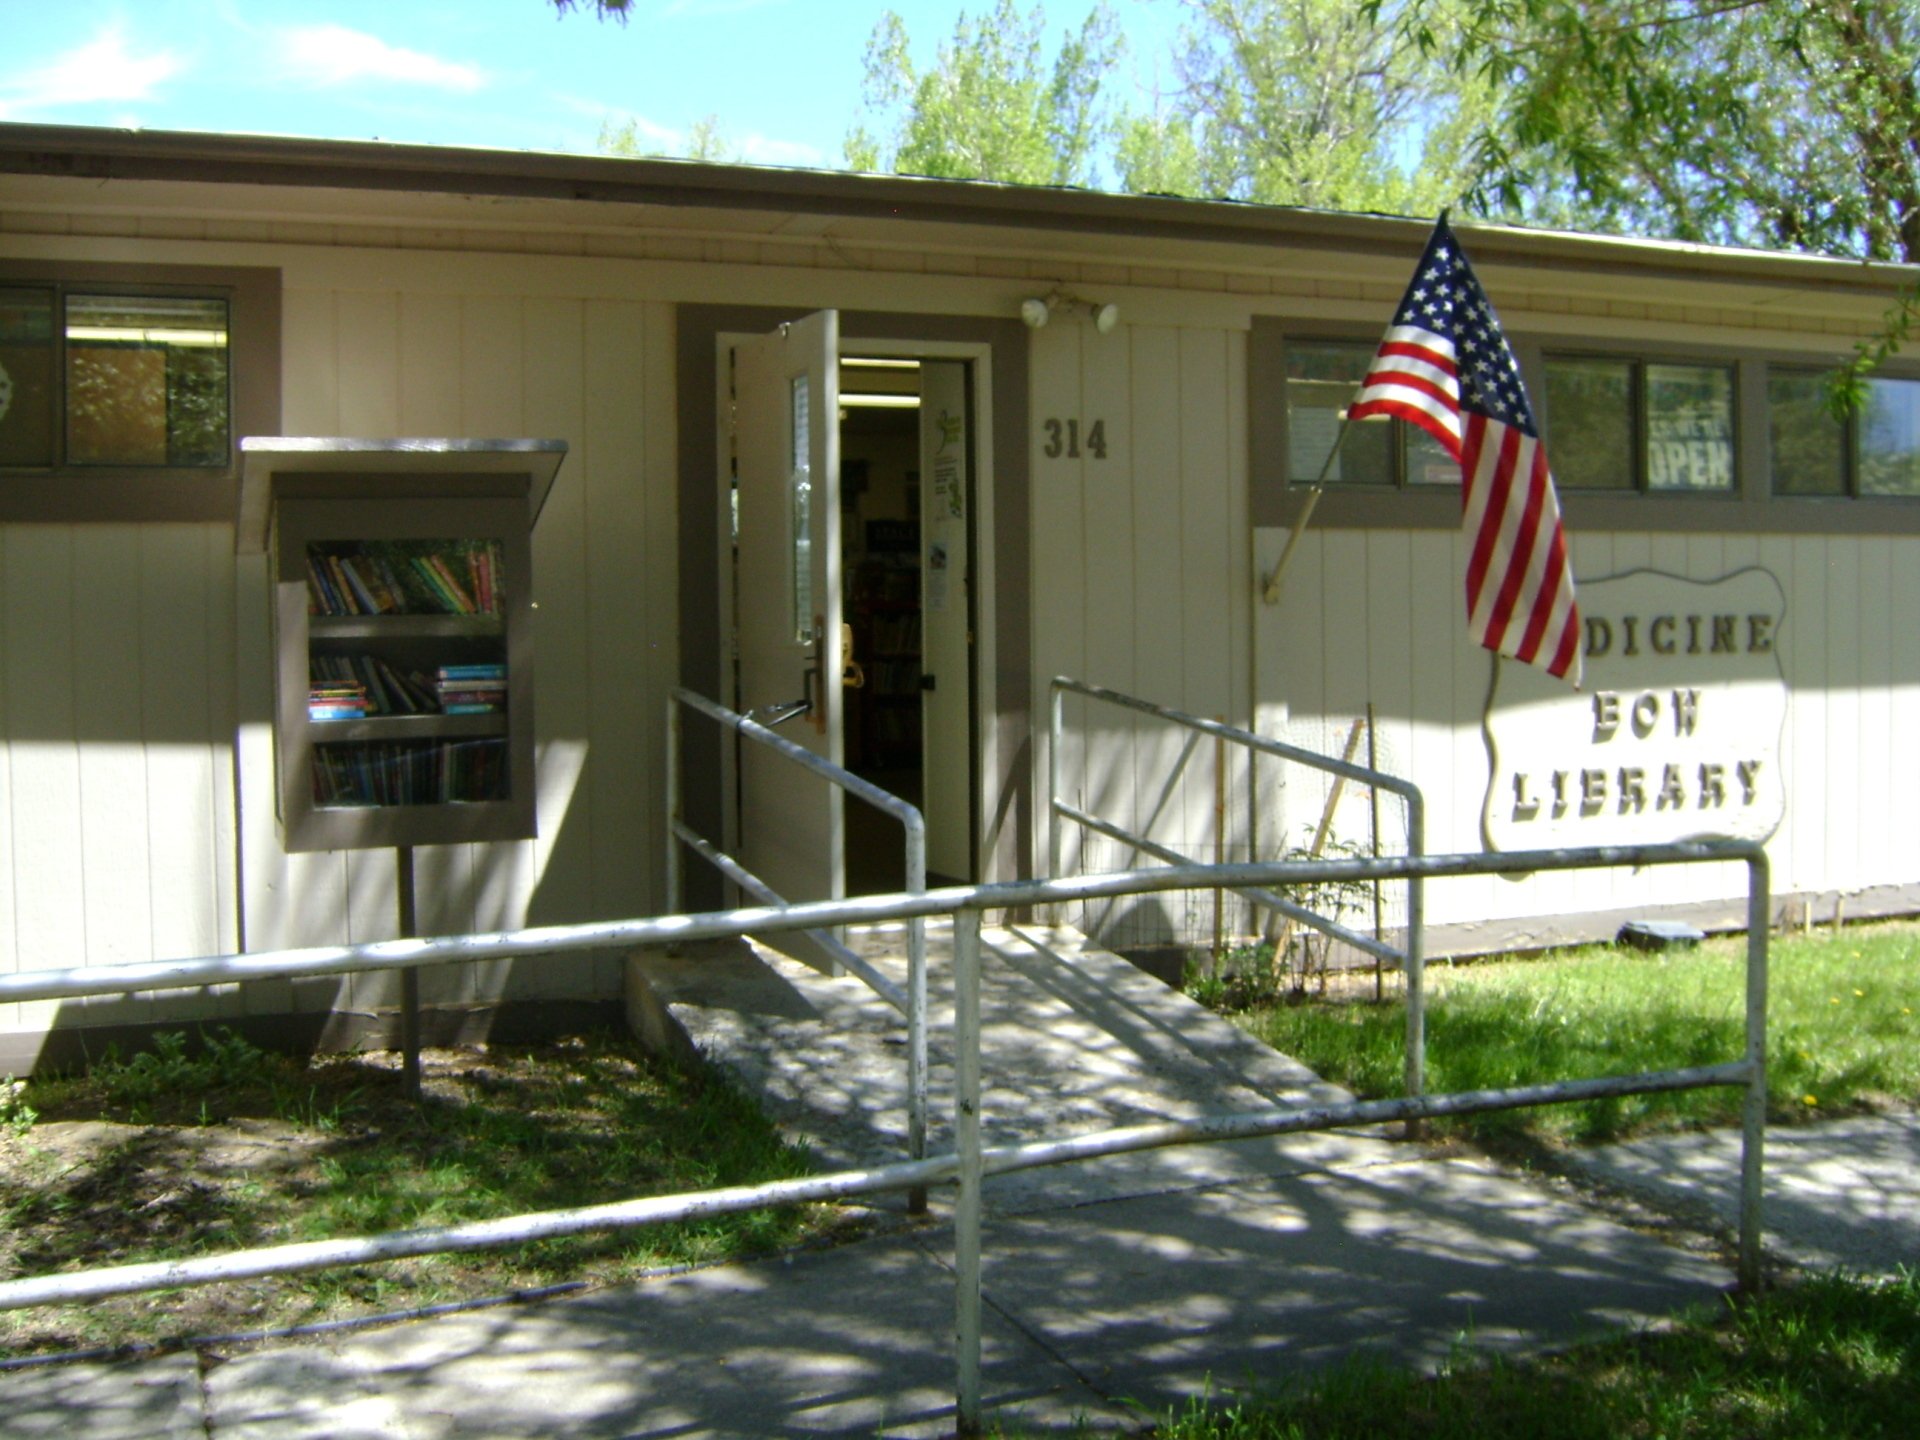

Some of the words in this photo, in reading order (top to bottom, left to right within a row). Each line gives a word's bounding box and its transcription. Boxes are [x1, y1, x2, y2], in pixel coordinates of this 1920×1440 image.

[1044, 418, 1107, 459] 314
[1648, 441, 1731, 486] OPEN
[1585, 614, 1773, 657] DICINE
[1592, 688, 1701, 741] BOW
[1512, 759, 1762, 819] LIBRARY
